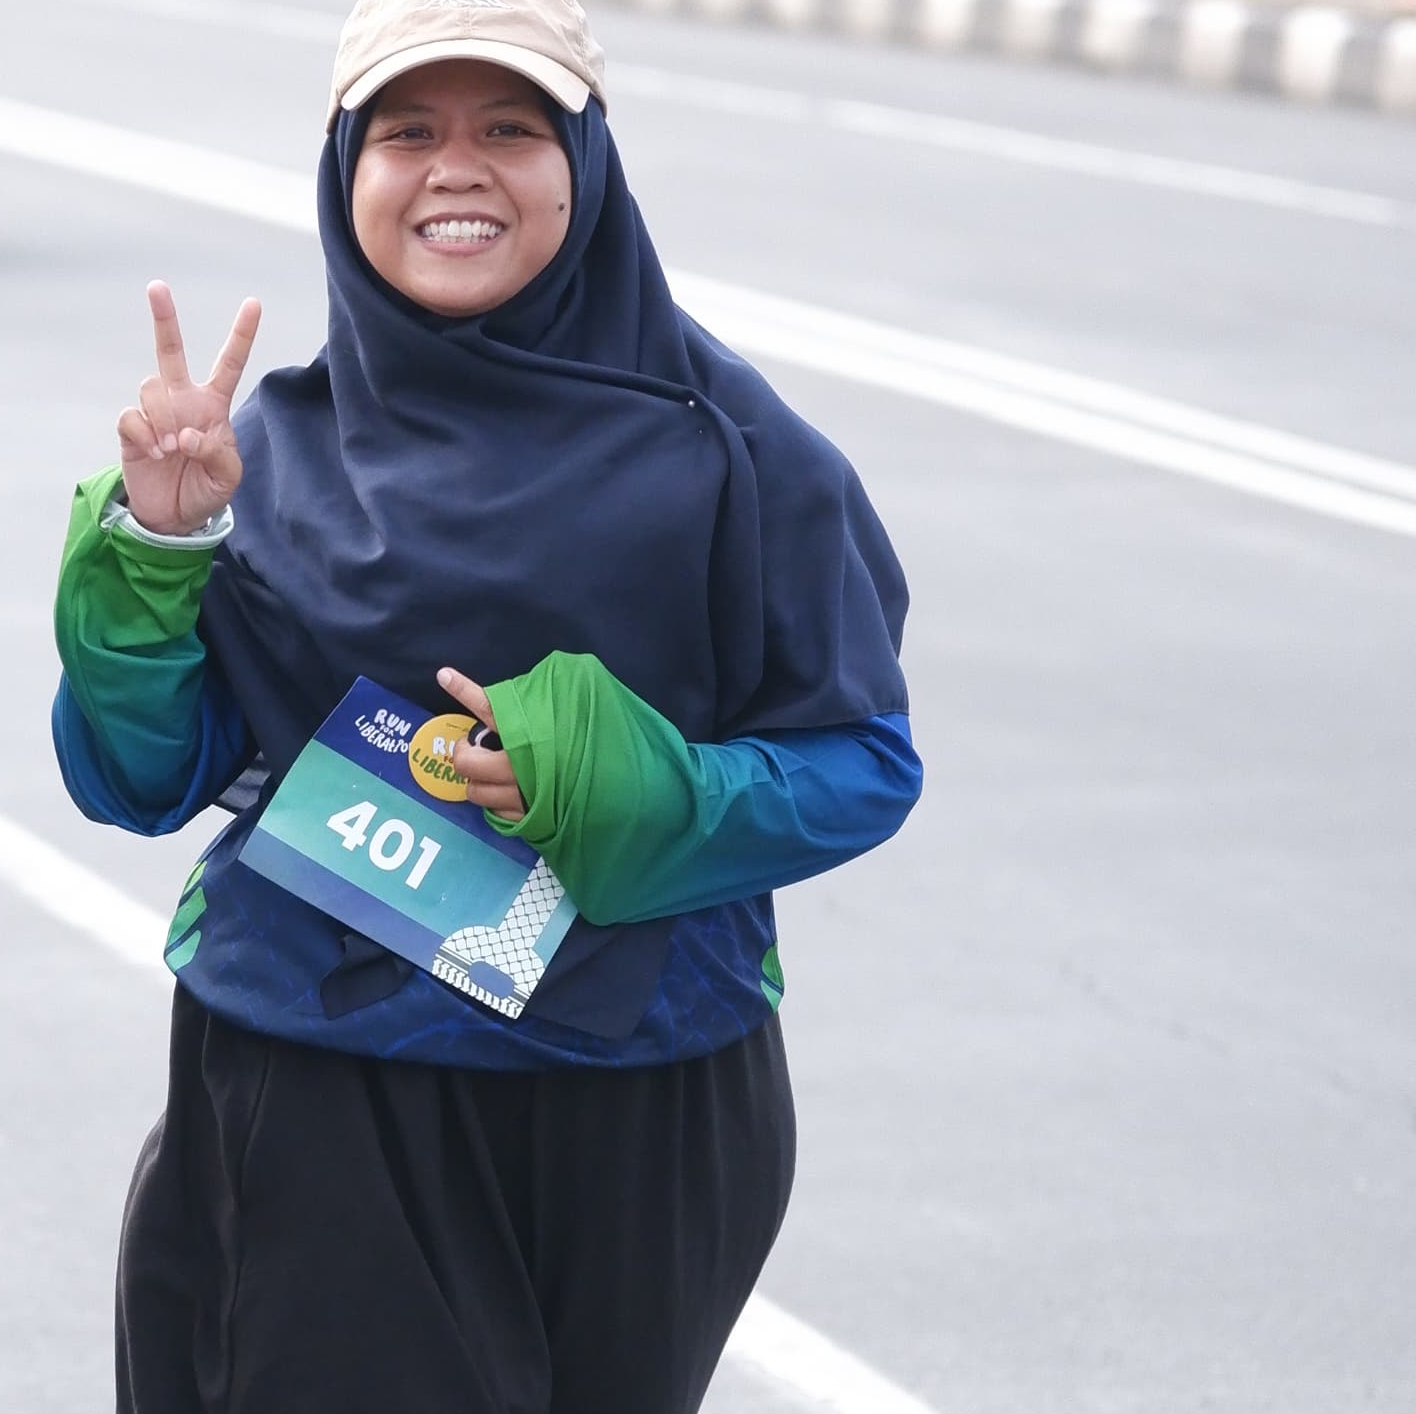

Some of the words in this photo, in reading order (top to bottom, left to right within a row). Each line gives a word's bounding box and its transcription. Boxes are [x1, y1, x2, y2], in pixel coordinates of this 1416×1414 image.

[355, 715, 409, 753] LIBERATIO
[374, 709, 412, 736] RUN
[379, 724, 394, 736] FOR
[326, 800, 443, 891] 401
